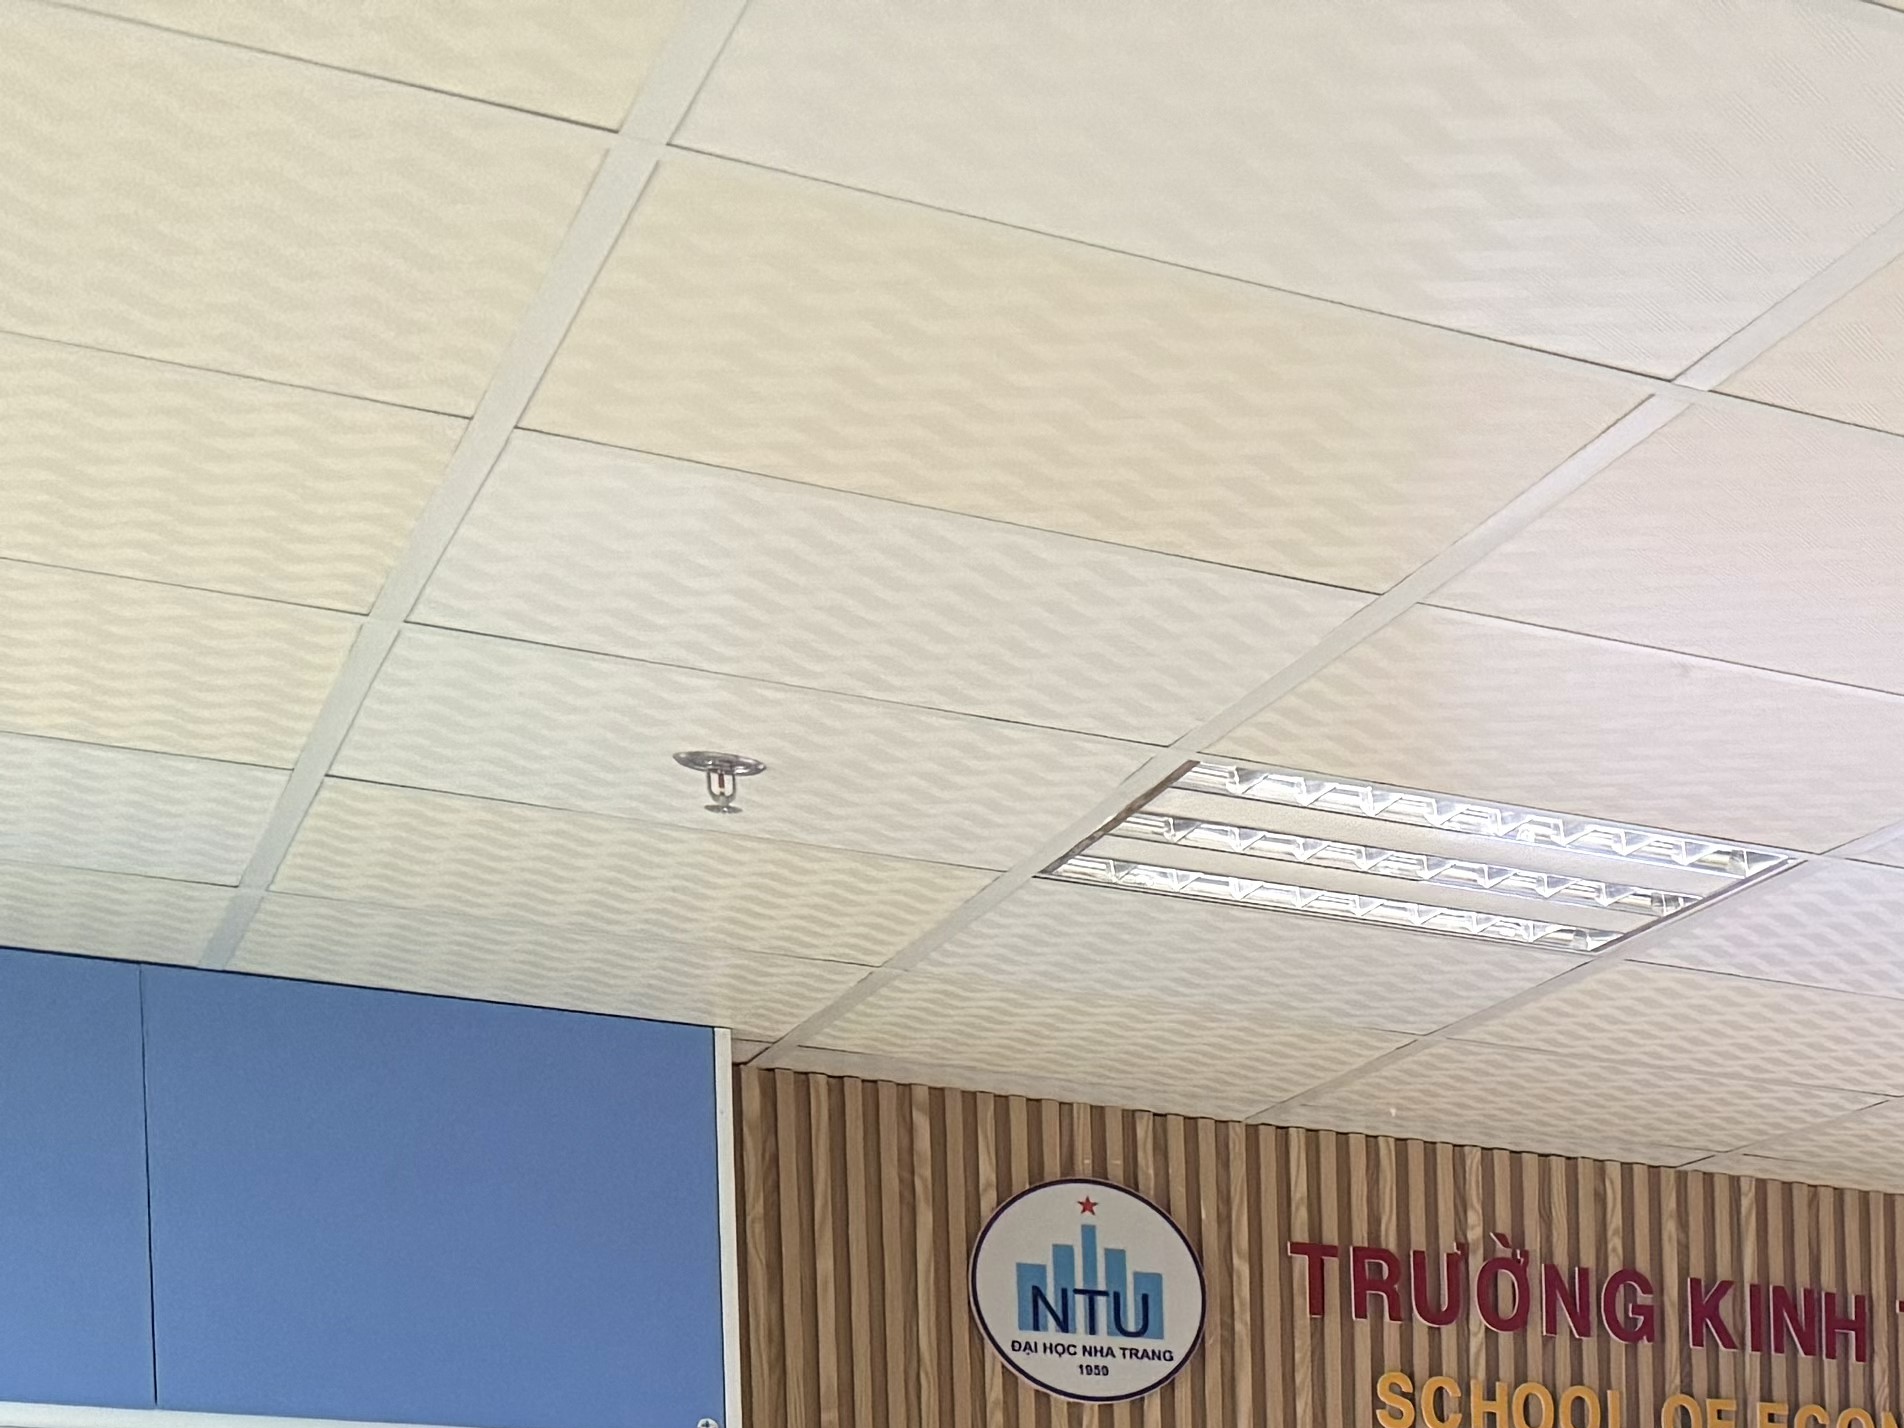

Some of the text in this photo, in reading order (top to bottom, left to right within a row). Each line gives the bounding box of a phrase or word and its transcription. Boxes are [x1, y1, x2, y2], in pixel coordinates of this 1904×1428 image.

[1032, 1285, 1149, 1338] NTU
[1288, 1231, 1657, 1345] TRƯỜNG
[1687, 1276, 1868, 1364] KINH
[1011, 1340, 1174, 1362] ĐẠI HỌC NHA TRANG
